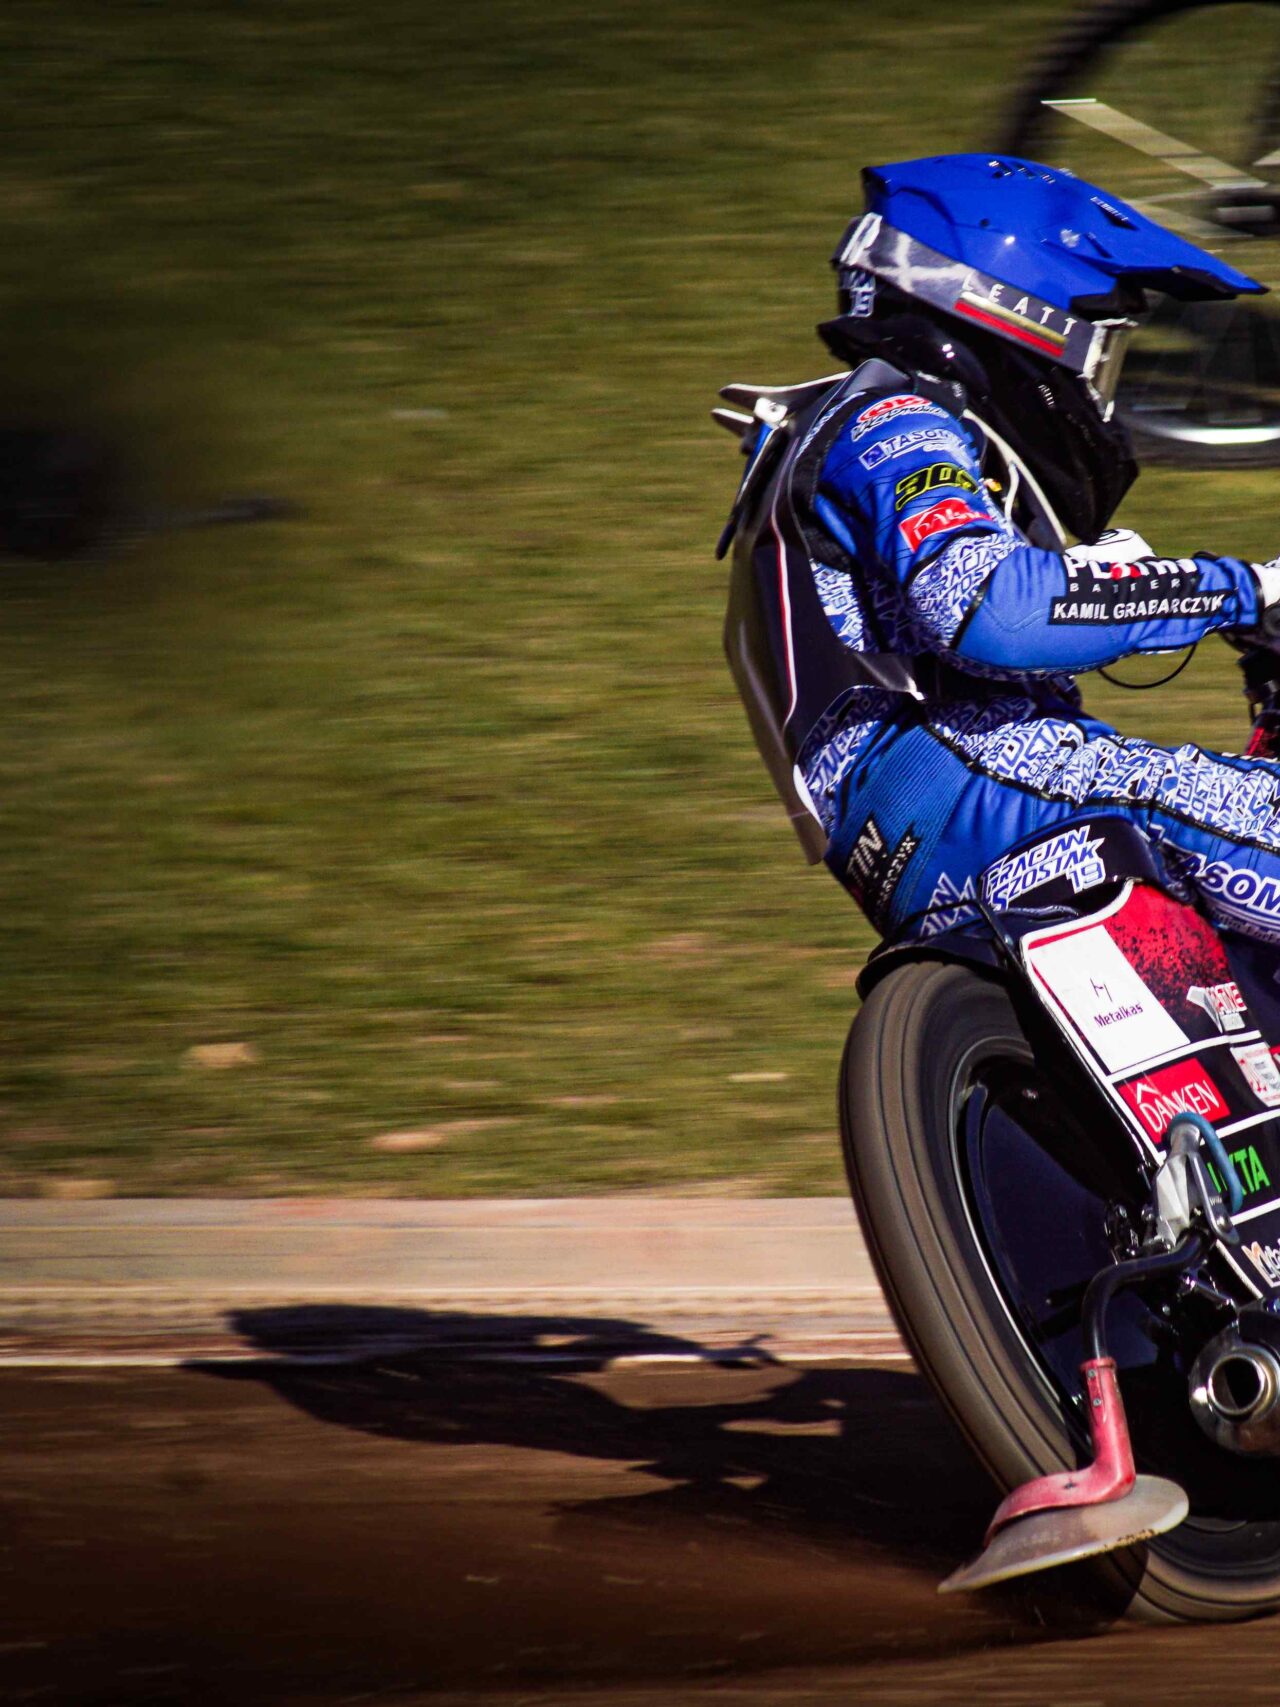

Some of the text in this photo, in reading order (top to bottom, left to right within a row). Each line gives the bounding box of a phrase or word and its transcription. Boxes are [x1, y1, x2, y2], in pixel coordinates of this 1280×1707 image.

[961, 276, 1077, 337] LEATT
[1053, 602, 1110, 621] KAMIL
[1112, 594, 1226, 619] GRABARCZYK
[1065, 858, 1107, 894] 19
[1093, 1003, 1144, 1027] Metalkas
[1138, 1080, 1220, 1133] DANKEN
